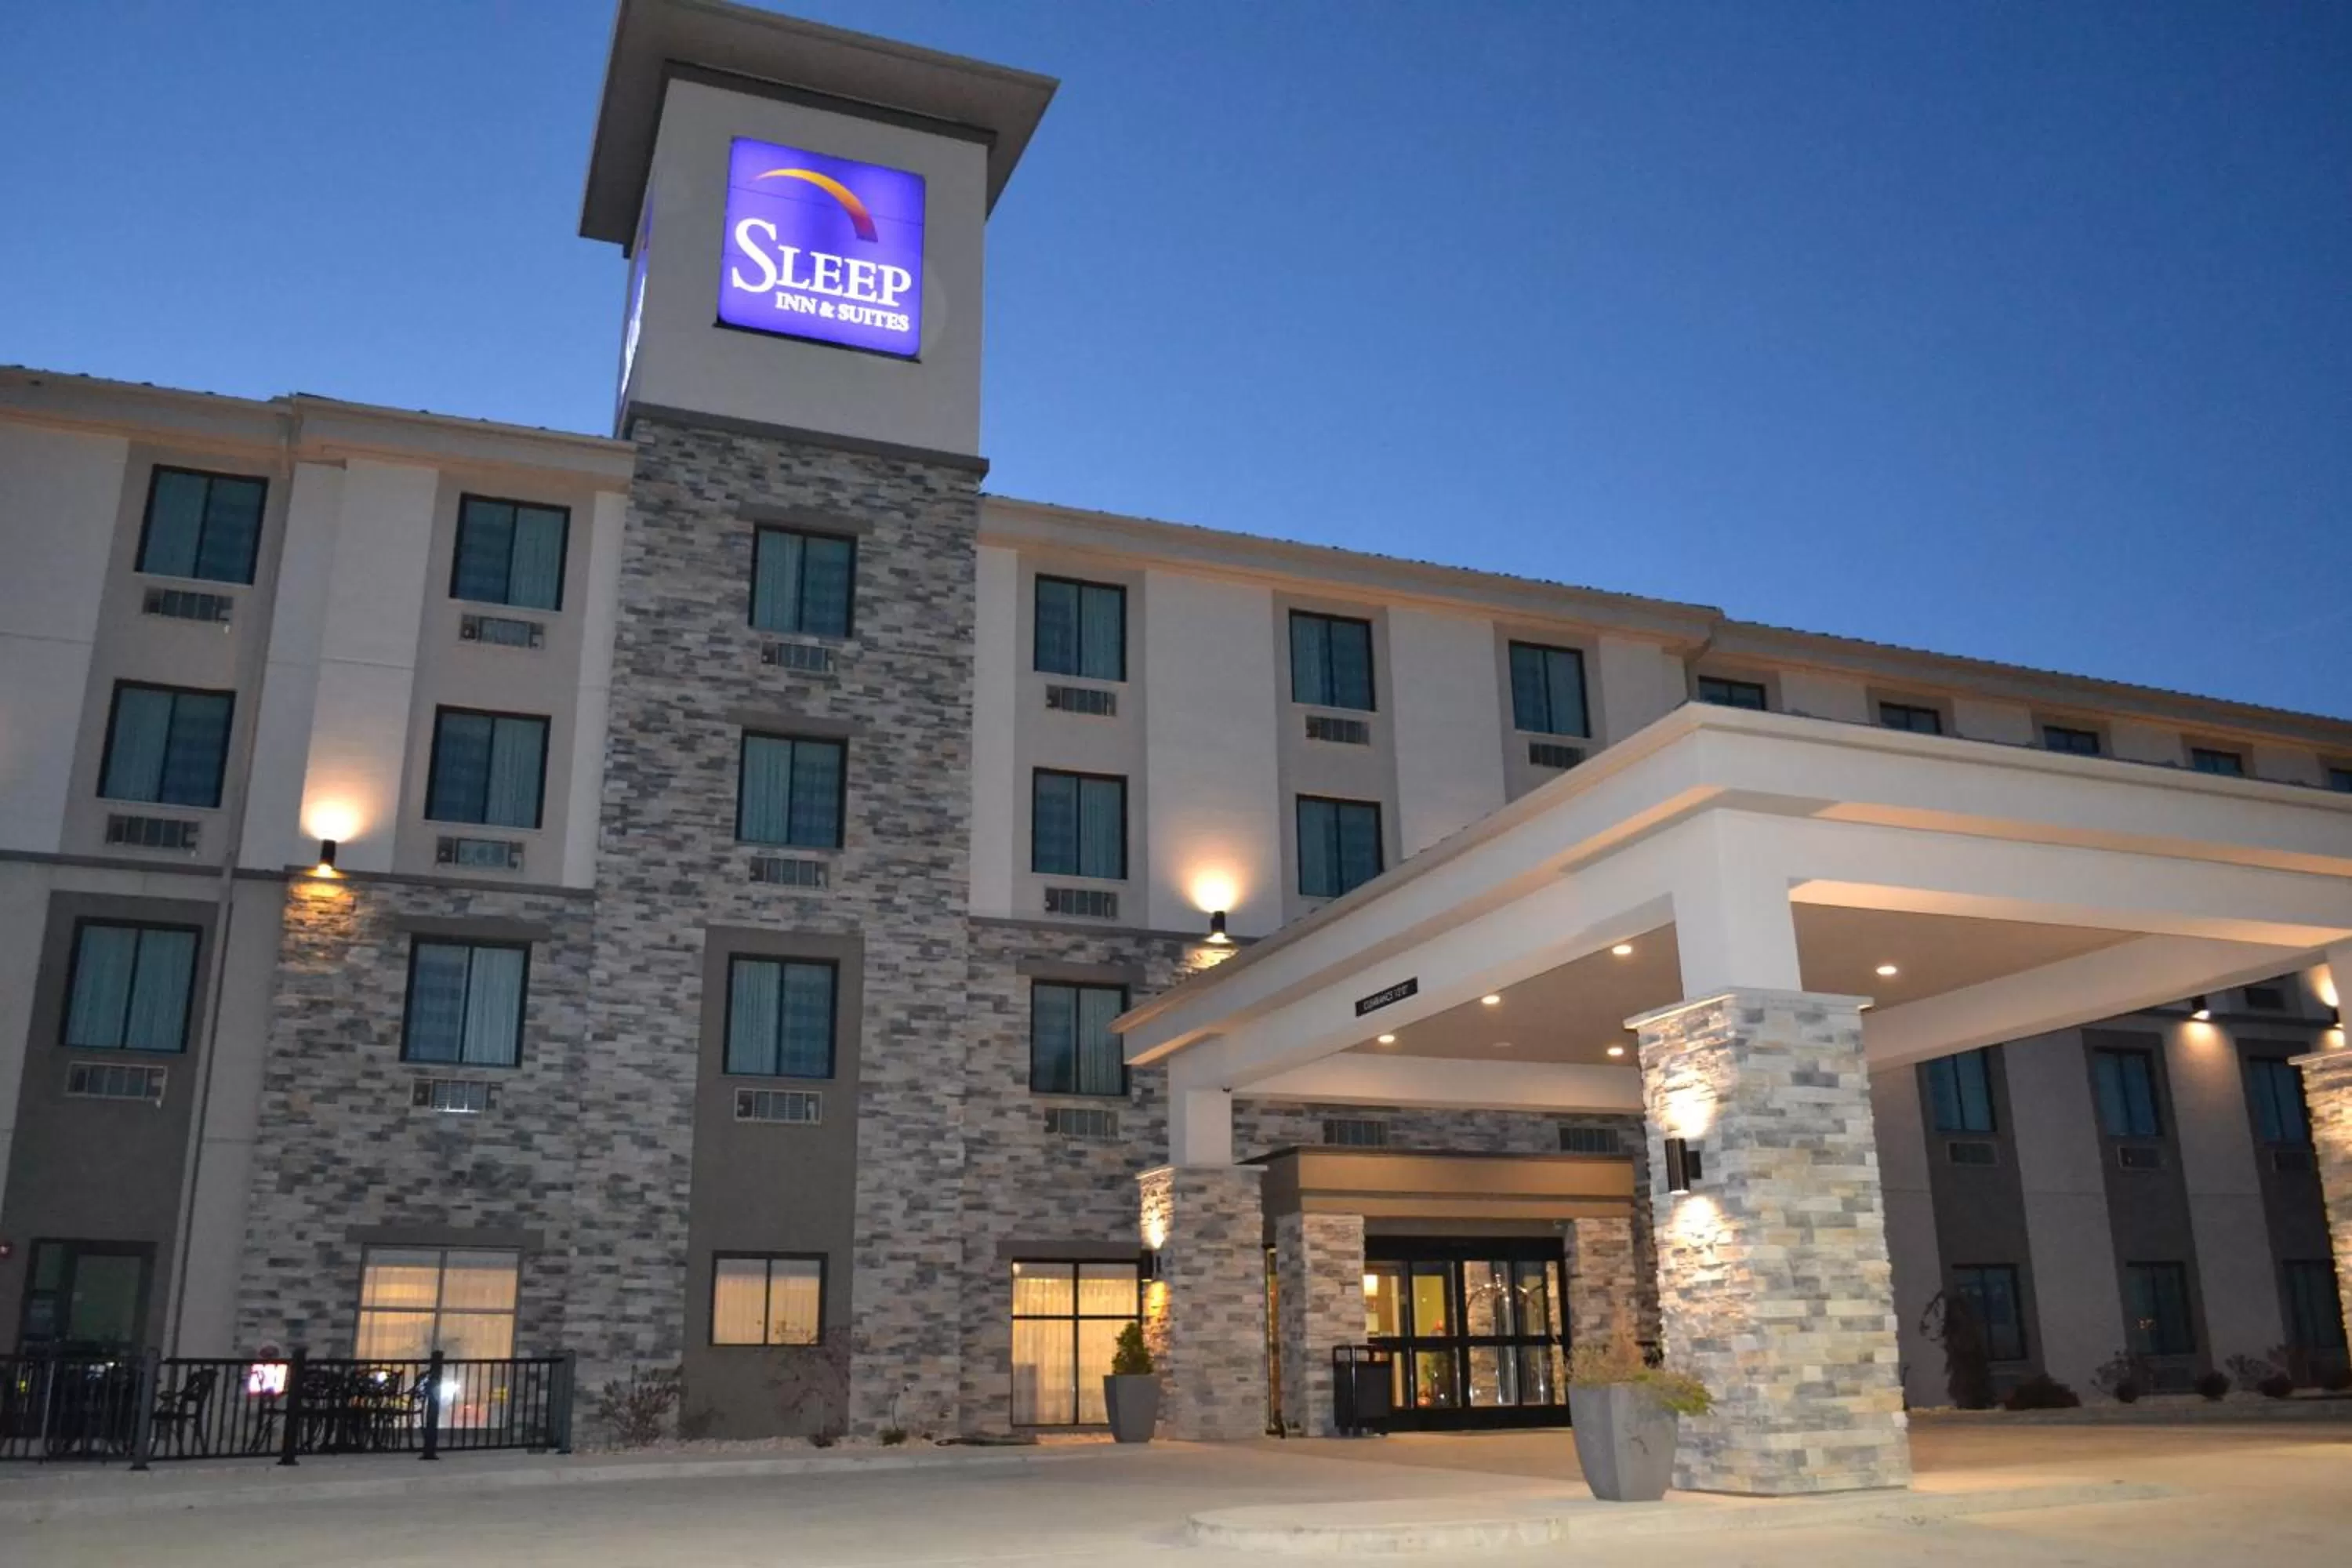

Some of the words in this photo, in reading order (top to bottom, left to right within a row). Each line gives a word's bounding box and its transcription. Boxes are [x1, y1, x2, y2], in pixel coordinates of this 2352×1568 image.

[731, 217, 912, 307] SLEEP
[775, 291, 817, 314] INN
[818, 301, 836, 319] &
[837, 303, 910, 332] SUITES
